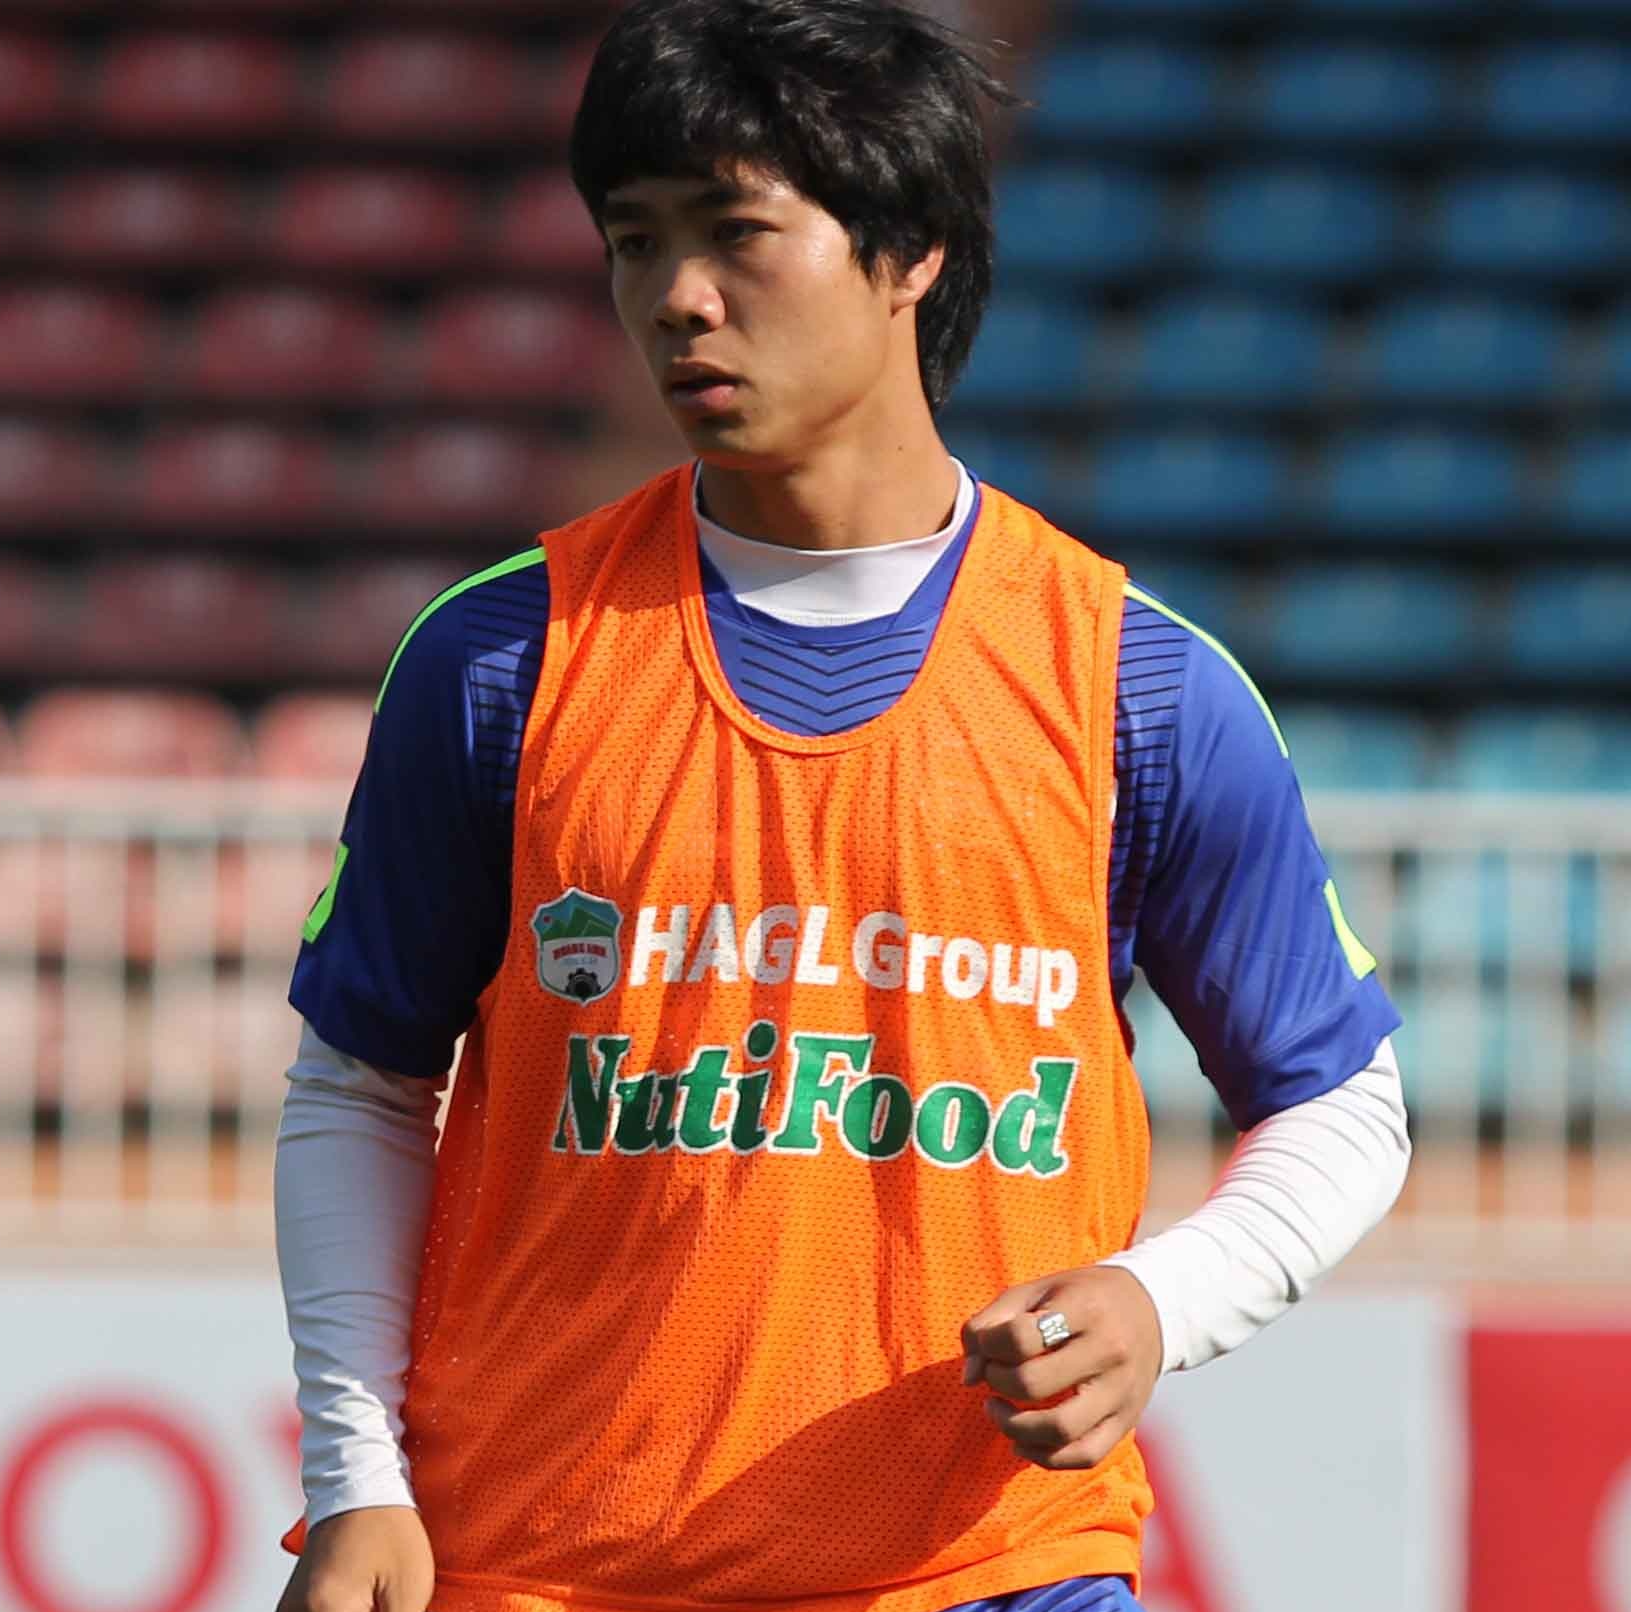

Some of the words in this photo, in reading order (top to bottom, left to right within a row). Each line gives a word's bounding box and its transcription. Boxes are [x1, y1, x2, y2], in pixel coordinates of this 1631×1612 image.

[629, 903, 840, 987] HAGL
[852, 911, 1078, 1028] Group
[552, 1019, 1079, 1177] NutiFood
